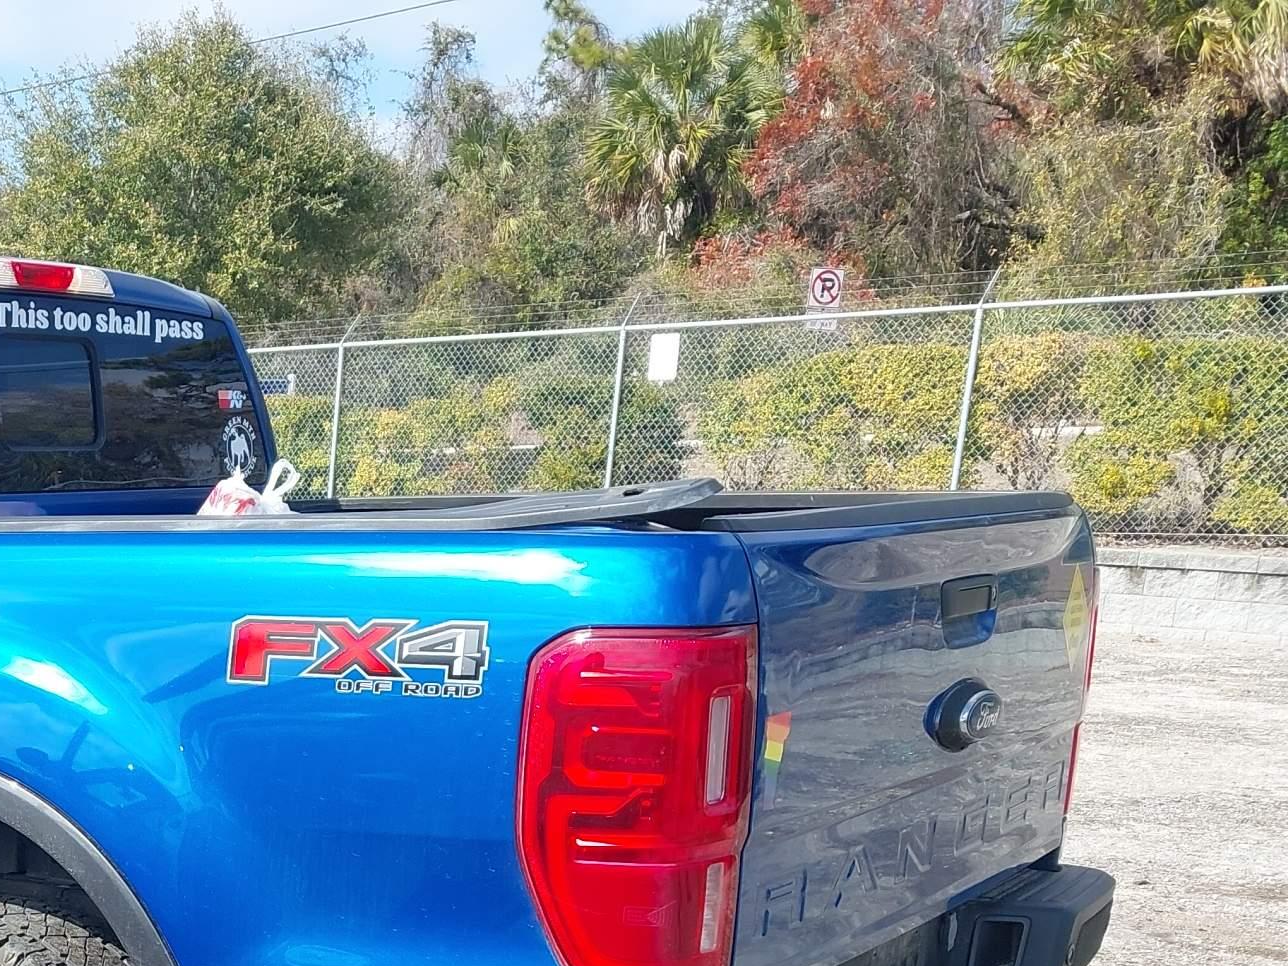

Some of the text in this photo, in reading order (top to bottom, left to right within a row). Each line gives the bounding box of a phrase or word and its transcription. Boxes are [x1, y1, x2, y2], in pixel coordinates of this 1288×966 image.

[53, 306, 92, 332] too
[95, 307, 151, 336] shall
[154, 318, 204, 343] pass
[226, 615, 490, 686] FX4
[335, 679, 482, 699] OFF ROAD
[976, 701, 1001, 731] Ford
[754, 759, 1066, 937] RANGER
